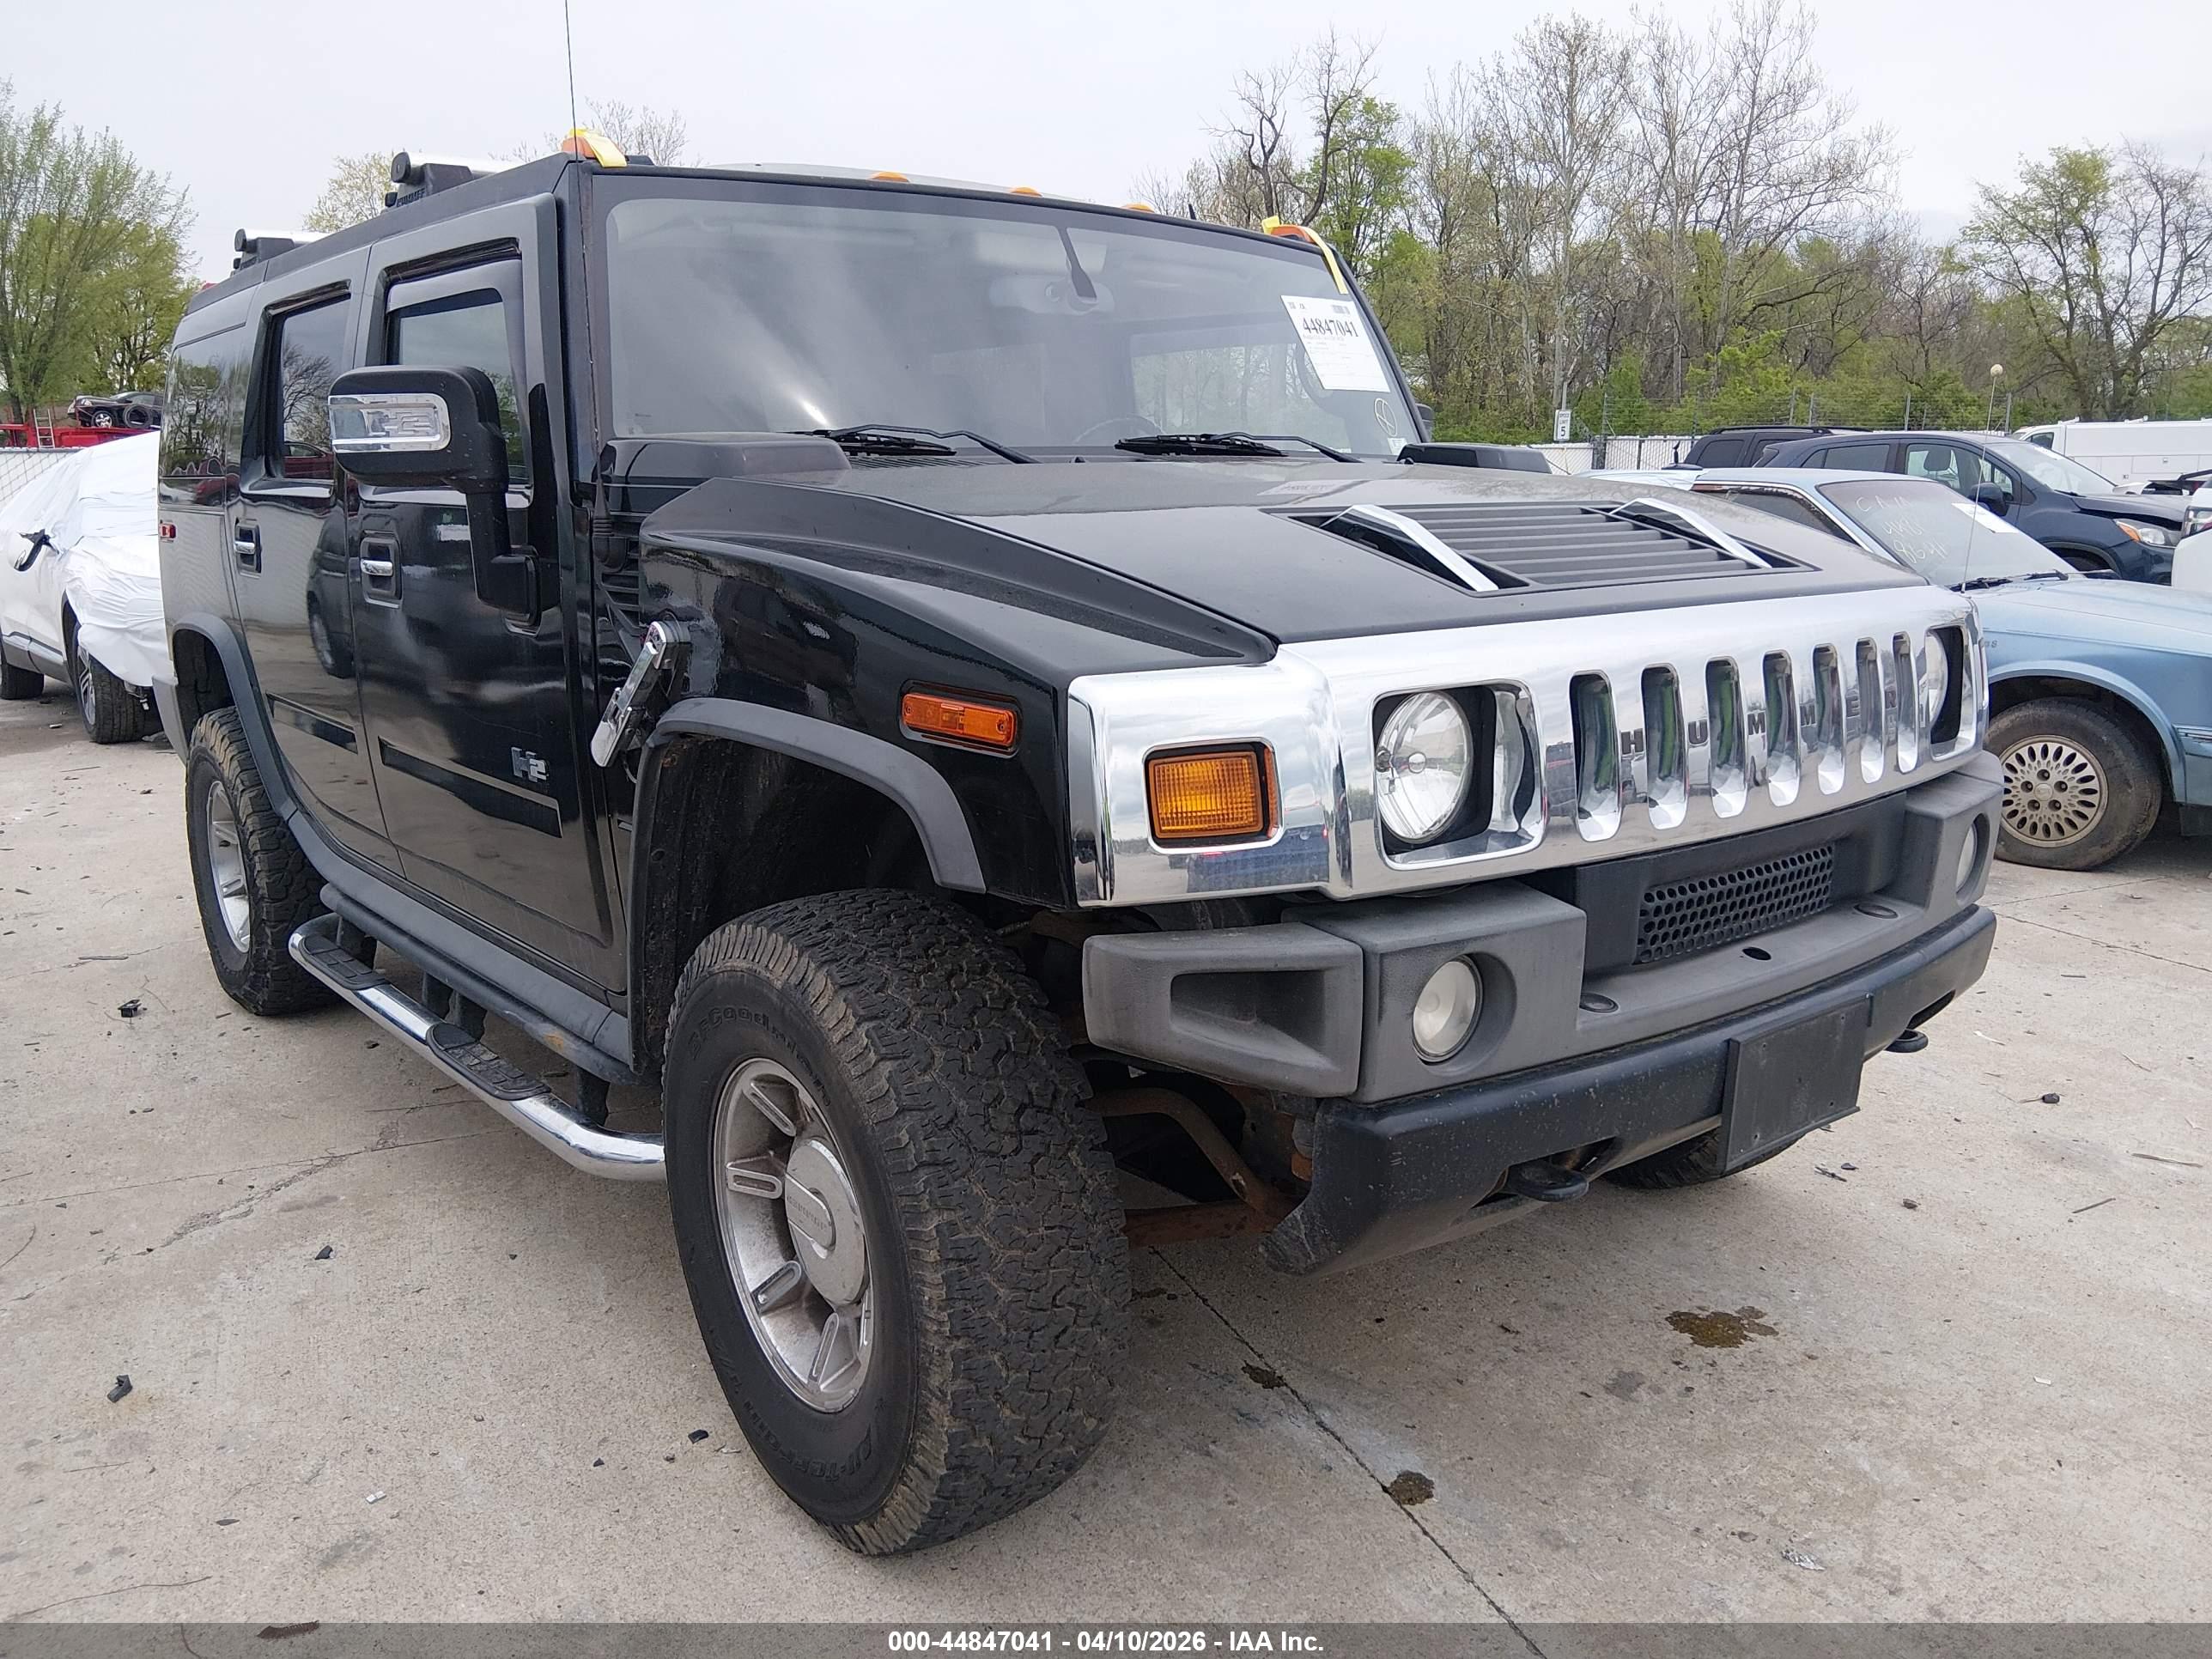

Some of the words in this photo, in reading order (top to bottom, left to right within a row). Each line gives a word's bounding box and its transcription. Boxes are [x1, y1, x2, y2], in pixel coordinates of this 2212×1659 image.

[1302, 317, 1359, 337] 44847041
[1560, 426, 1566, 437] 5
[1620, 688, 1898, 756] HUMMER
[511, 746, 547, 783] H2
